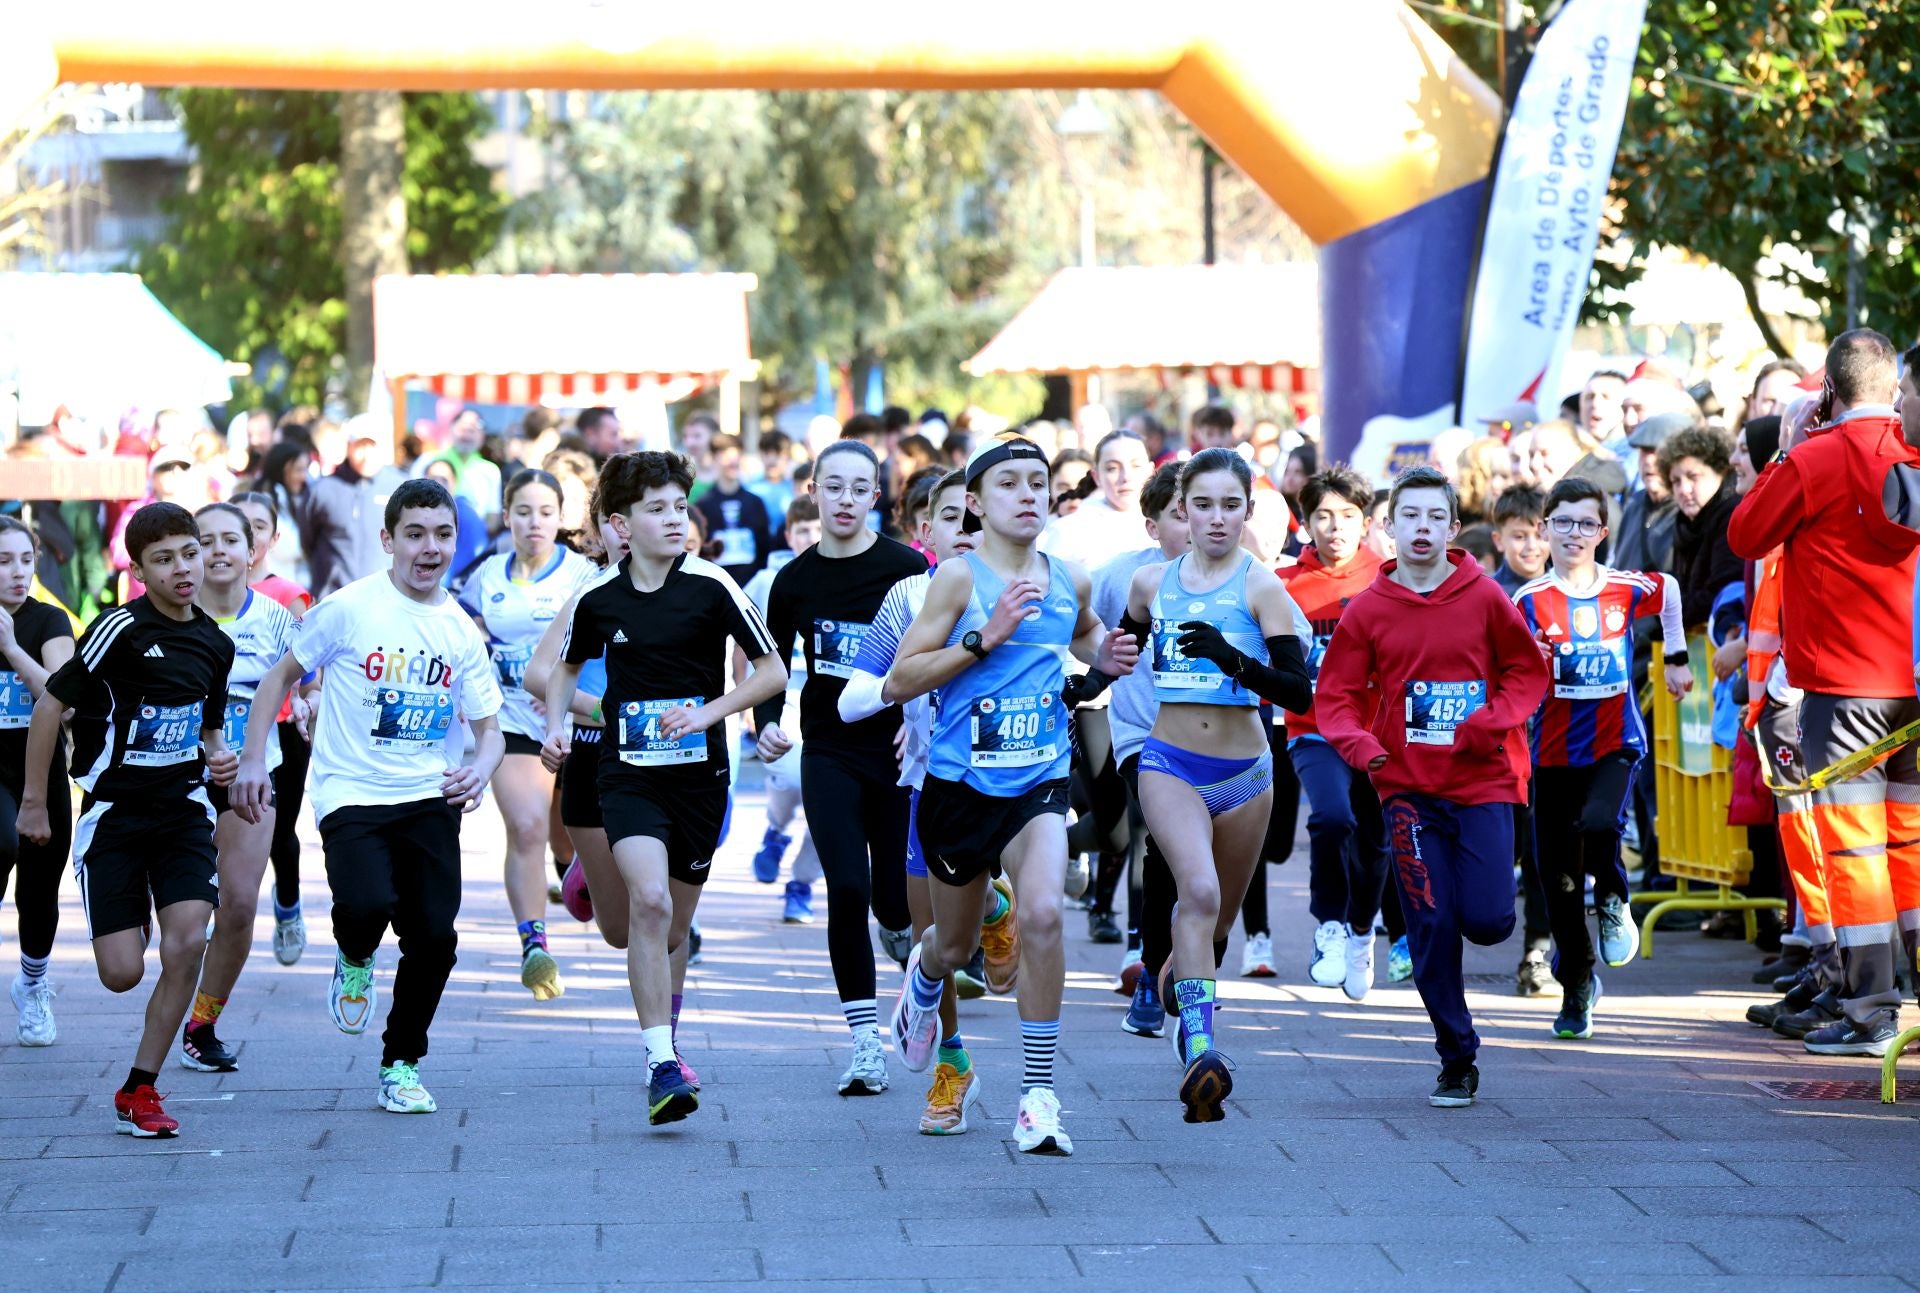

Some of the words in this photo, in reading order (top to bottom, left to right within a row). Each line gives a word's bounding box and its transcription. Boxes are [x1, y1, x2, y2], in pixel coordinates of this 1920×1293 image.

[1577, 36, 1610, 124] Grado
[1538, 76, 1573, 206] Deportes
[1574, 134, 1596, 169] de
[1562, 181, 1591, 253] Ayto.
[1531, 217, 1556, 252] de
[837, 636, 862, 658] 45
[1169, 662, 1190, 671] SOFI
[1575, 655, 1611, 678] 447
[1585, 678, 1602, 686] NEL
[396, 708, 436, 731] 464
[1428, 698, 1467, 721] 452
[152, 719, 189, 744] 459
[222, 720, 233, 742] 1
[397, 731, 426, 740] MATEO
[997, 712, 1040, 740] 460
[154, 743, 180, 752] YAHYA
[646, 741, 680, 750] PEDRO
[1001, 739, 1036, 750] GONZA
